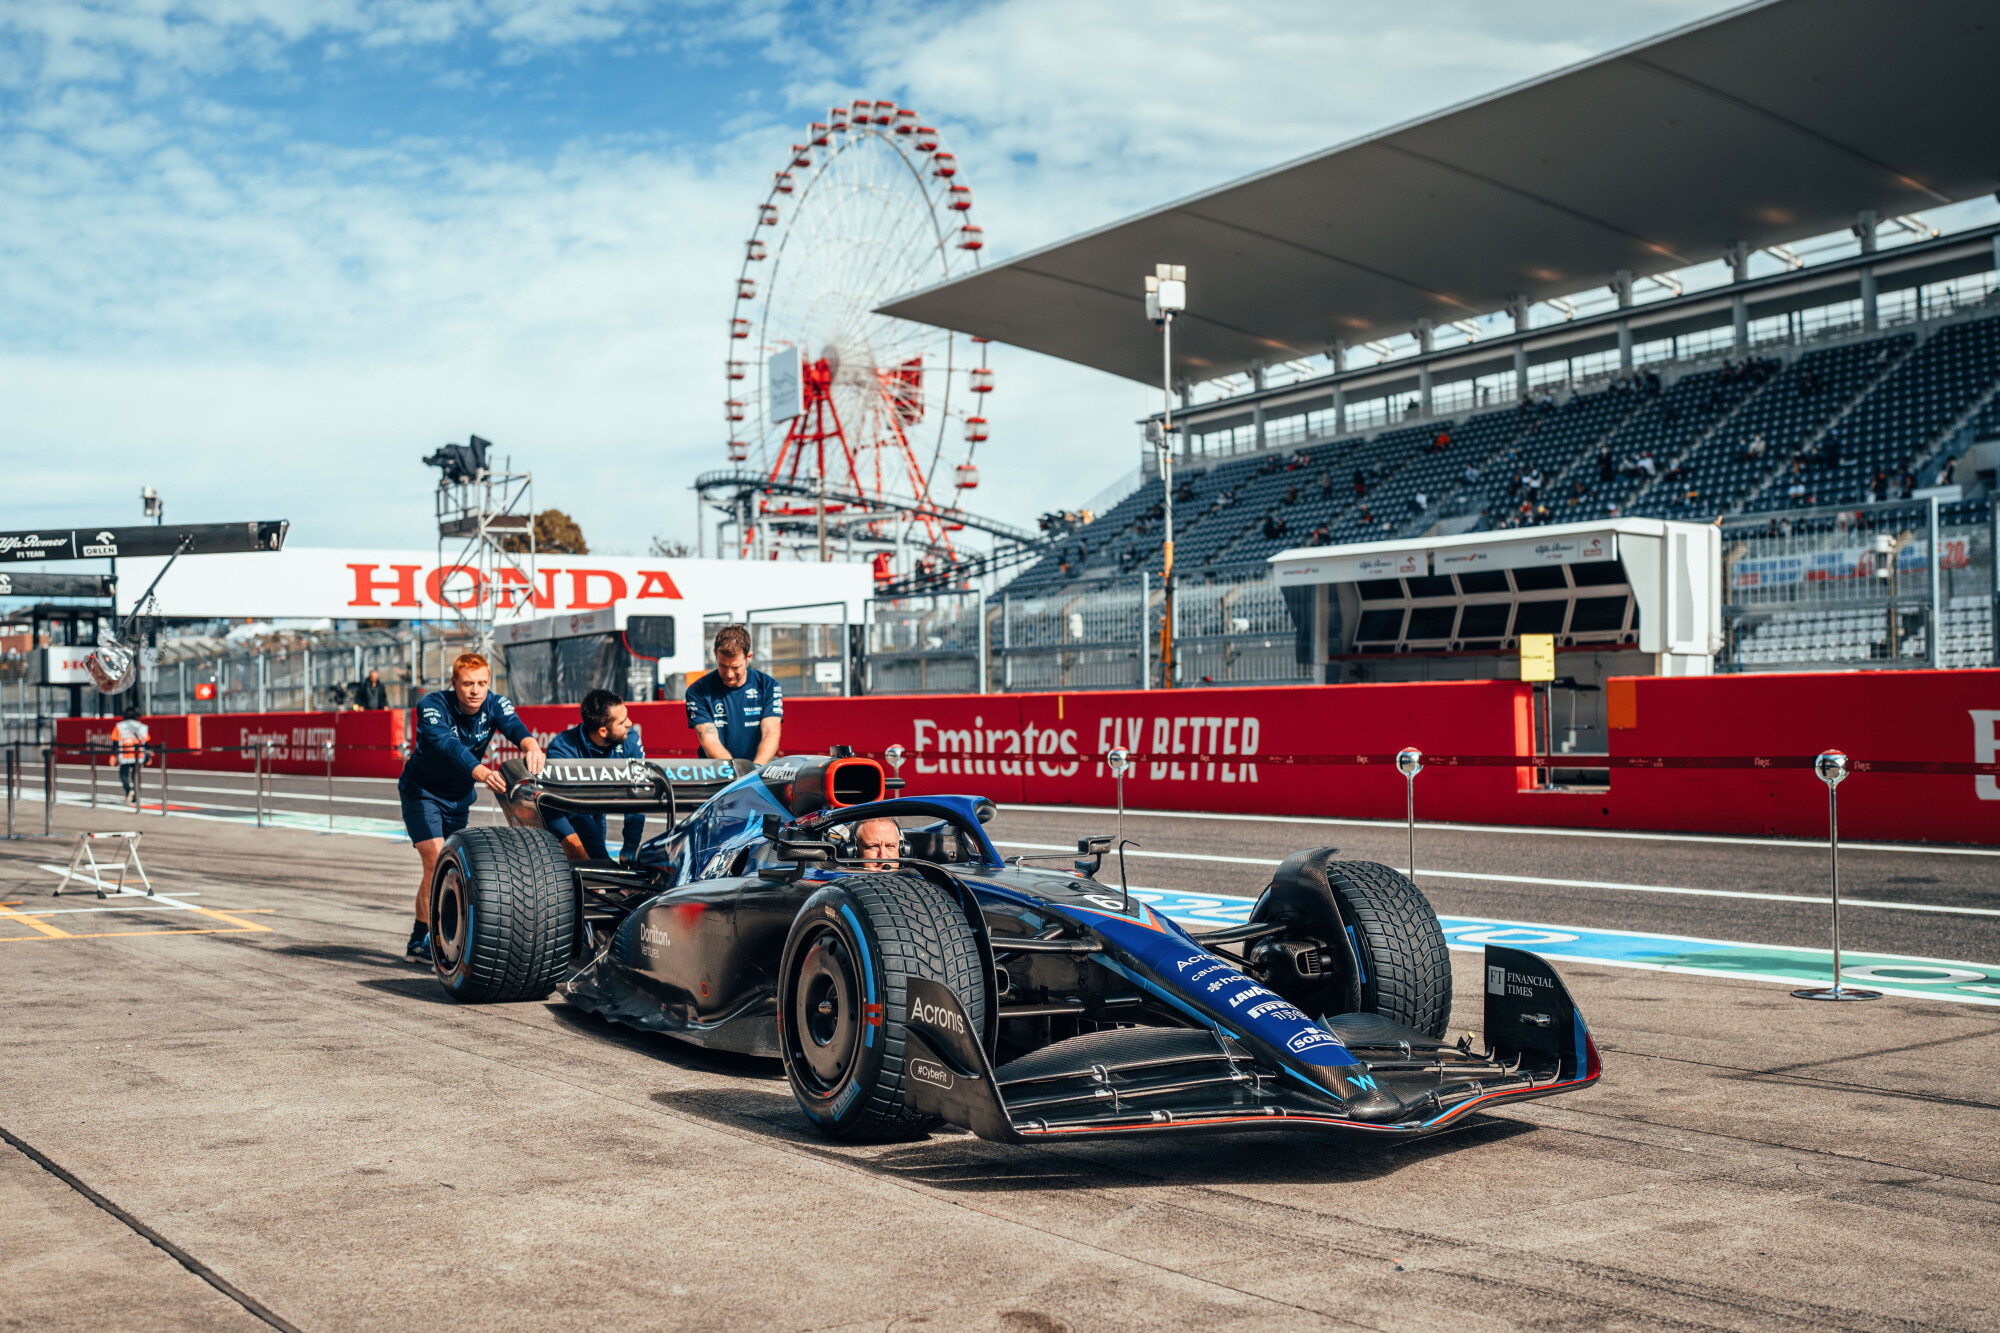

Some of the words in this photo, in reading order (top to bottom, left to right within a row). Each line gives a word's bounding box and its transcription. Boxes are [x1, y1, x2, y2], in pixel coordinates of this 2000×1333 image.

[23, 534, 68, 548] Romeo
[26, 550, 46, 559] TEAM
[86, 546, 115, 555] ORLEN
[346, 563, 684, 610] HONDA
[913, 716, 1079, 777] Emirates
[1096, 717, 1144, 779] FLY
[1150, 717, 1260, 783] BETTER
[537, 765, 645, 781] WILLIAMS
[666, 765, 734, 781] ACING
[640, 942, 660, 959] Ventures
[1489, 969, 1504, 985] FT
[1507, 972, 1554, 989] FINANCIAL
[1507, 984, 1533, 998] TIMES
[911, 996, 966, 1035] Acronis
[917, 1064, 948, 1084] #CyberFit
